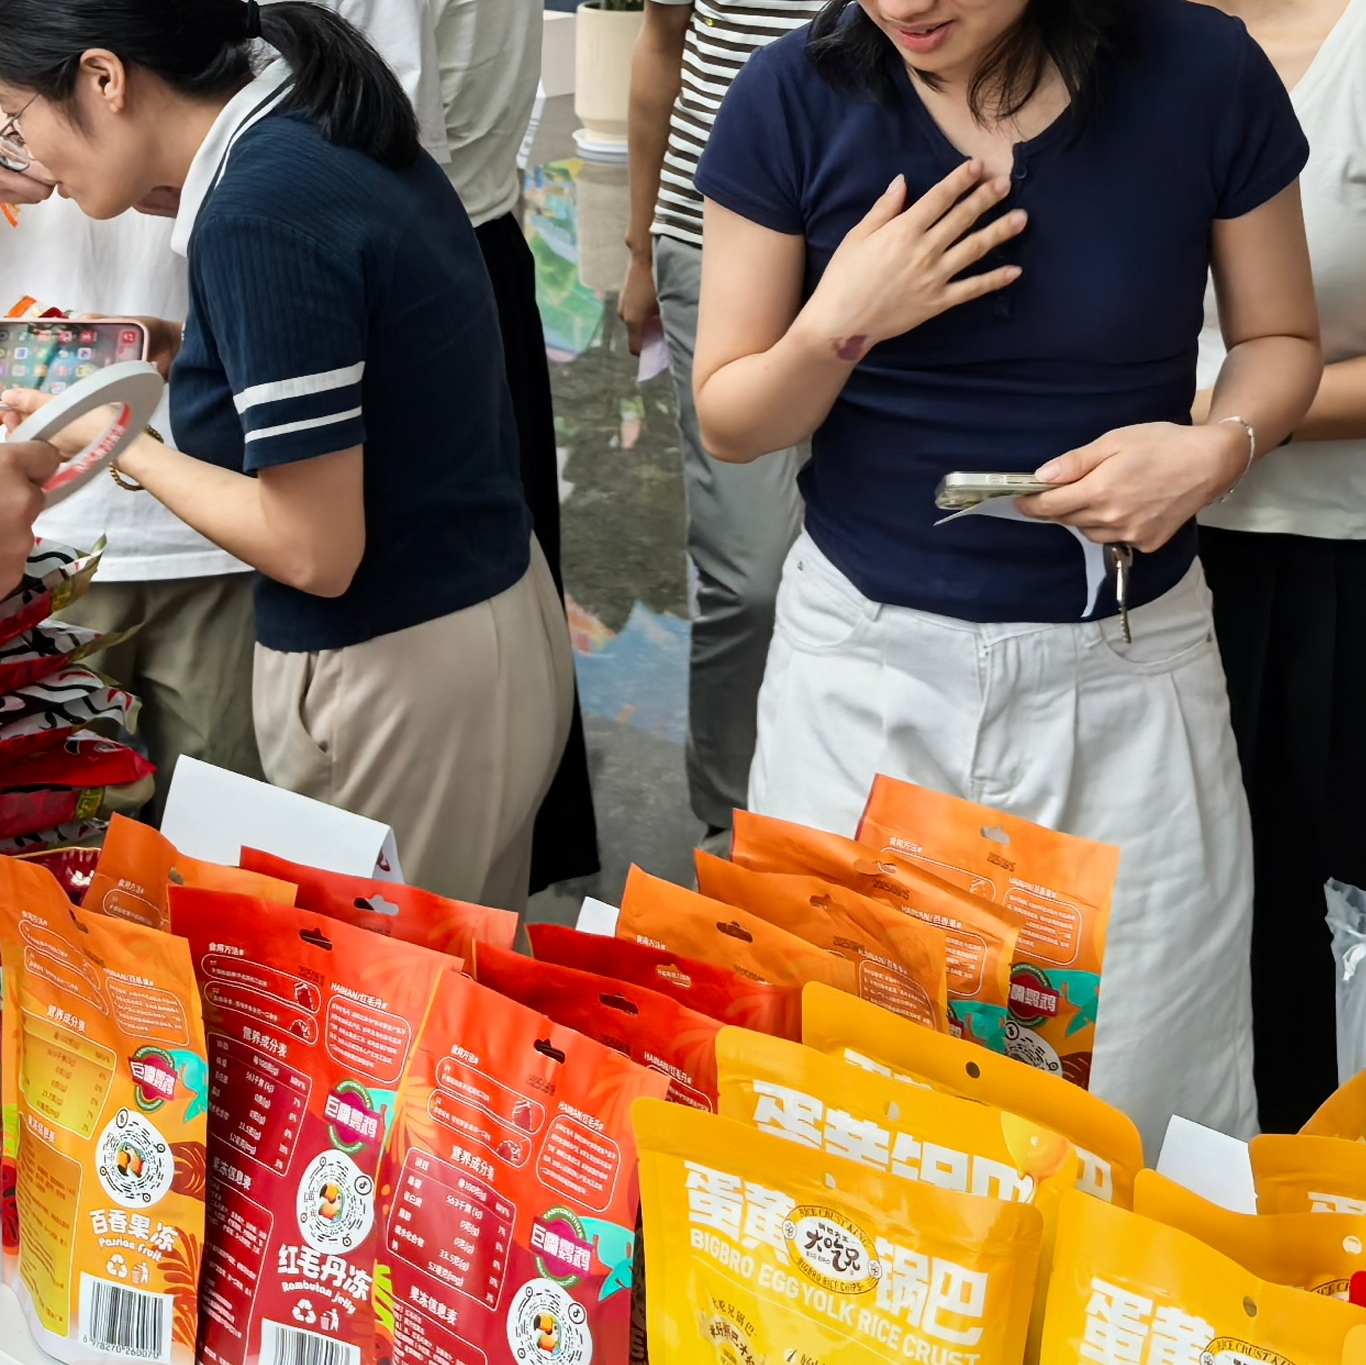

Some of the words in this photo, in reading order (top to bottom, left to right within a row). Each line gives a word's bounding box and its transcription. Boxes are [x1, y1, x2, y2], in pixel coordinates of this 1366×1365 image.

[1011, 982, 1058, 1013] 嘴鹦鹉
[242, 1025, 288, 1058] 营养成分表
[324, 1094, 378, 1138] 巨嘴鹦鹉
[450, 1145, 494, 1182] 营养成分表
[88, 1209, 179, 1252] 百香果冻
[530, 1222, 591, 1272] 巨嘴鹦鹉
[277, 1243, 373, 1301] 红毛丹冻
[684, 1159, 797, 1266] 蛋黄
[874, 1235, 989, 1347] 锅巴
[281, 1280, 333, 1299] Rambutan
[331, 1289, 357, 1315] jelly
[409, 1285, 458, 1326] 果冻信息表
[689, 1229, 754, 1278] BIGBRO
[758, 1264, 799, 1302] EGG
[802, 1282, 854, 1328] YOLK
[857, 1309, 908, 1351] RICE
